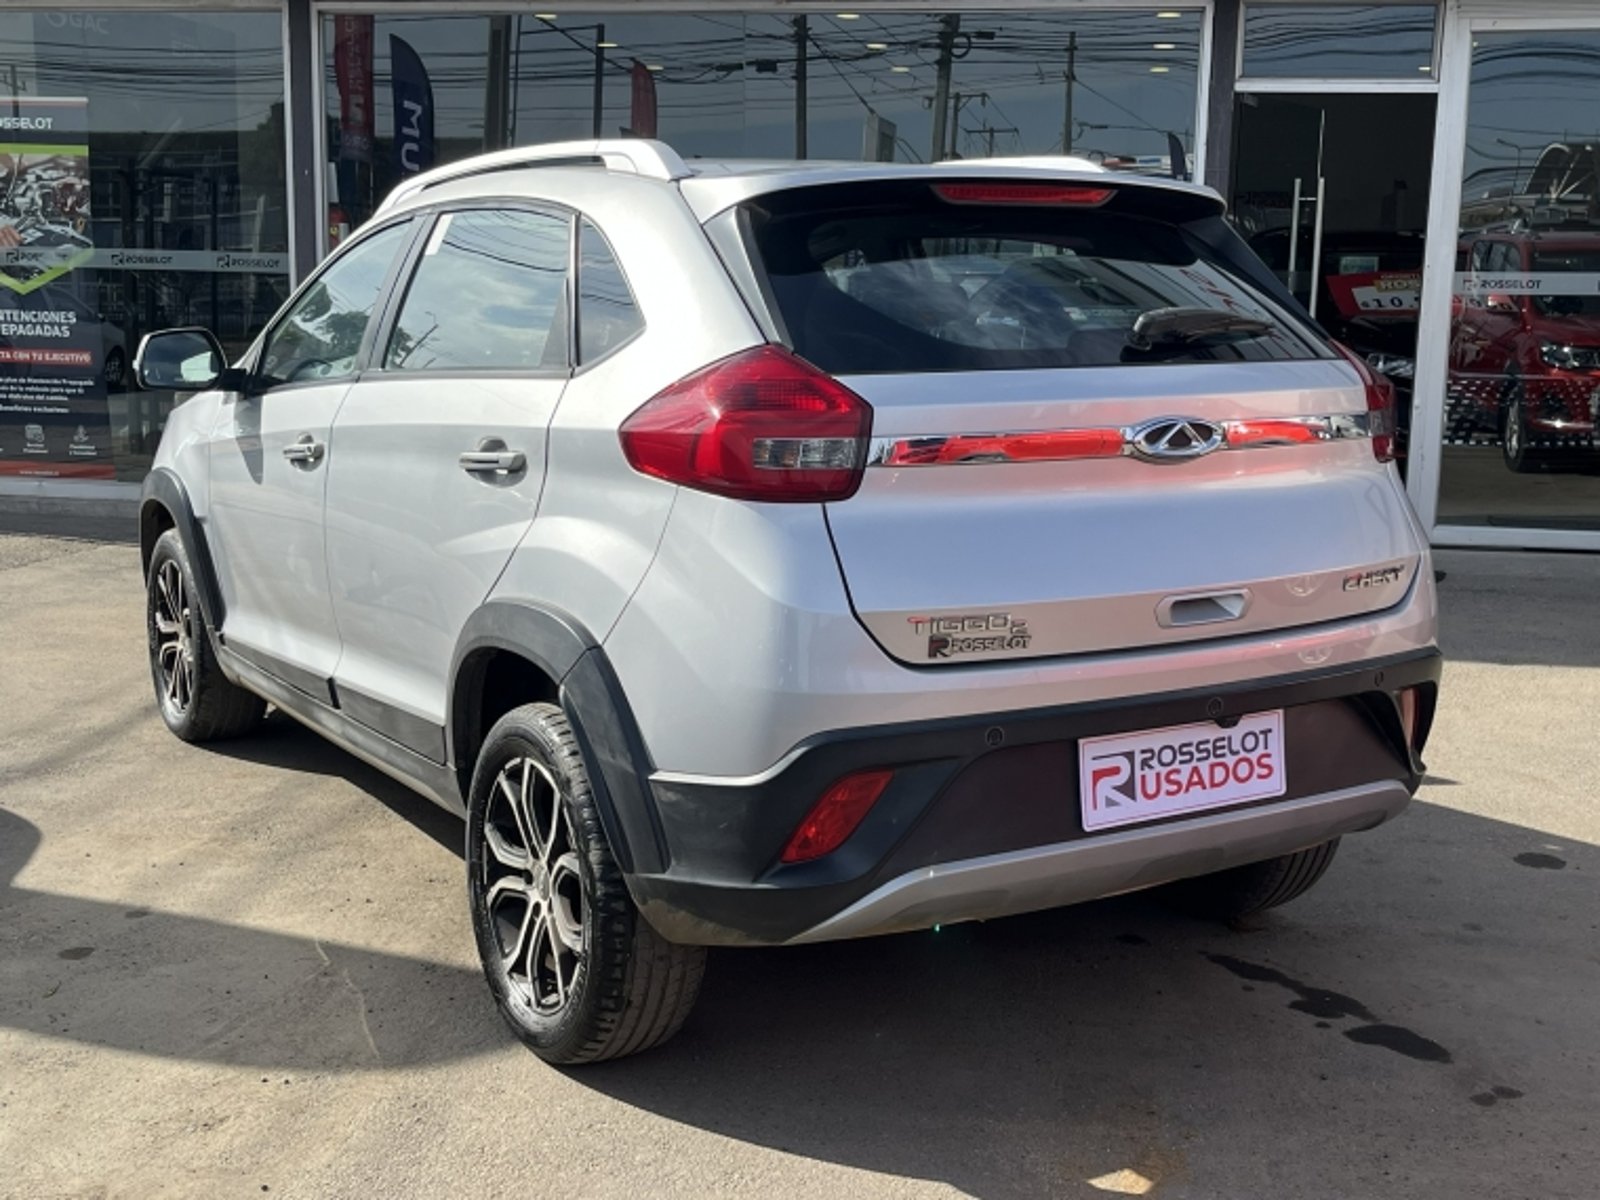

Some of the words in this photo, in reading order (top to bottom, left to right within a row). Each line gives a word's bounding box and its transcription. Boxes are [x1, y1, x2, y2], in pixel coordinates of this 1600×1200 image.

[1480, 279, 1541, 289] ROSSELOT
[951, 635, 1032, 653] ROSSELOT
[1140, 728, 1273, 771] ROSSELOT
[1140, 753, 1275, 800] USADOS
